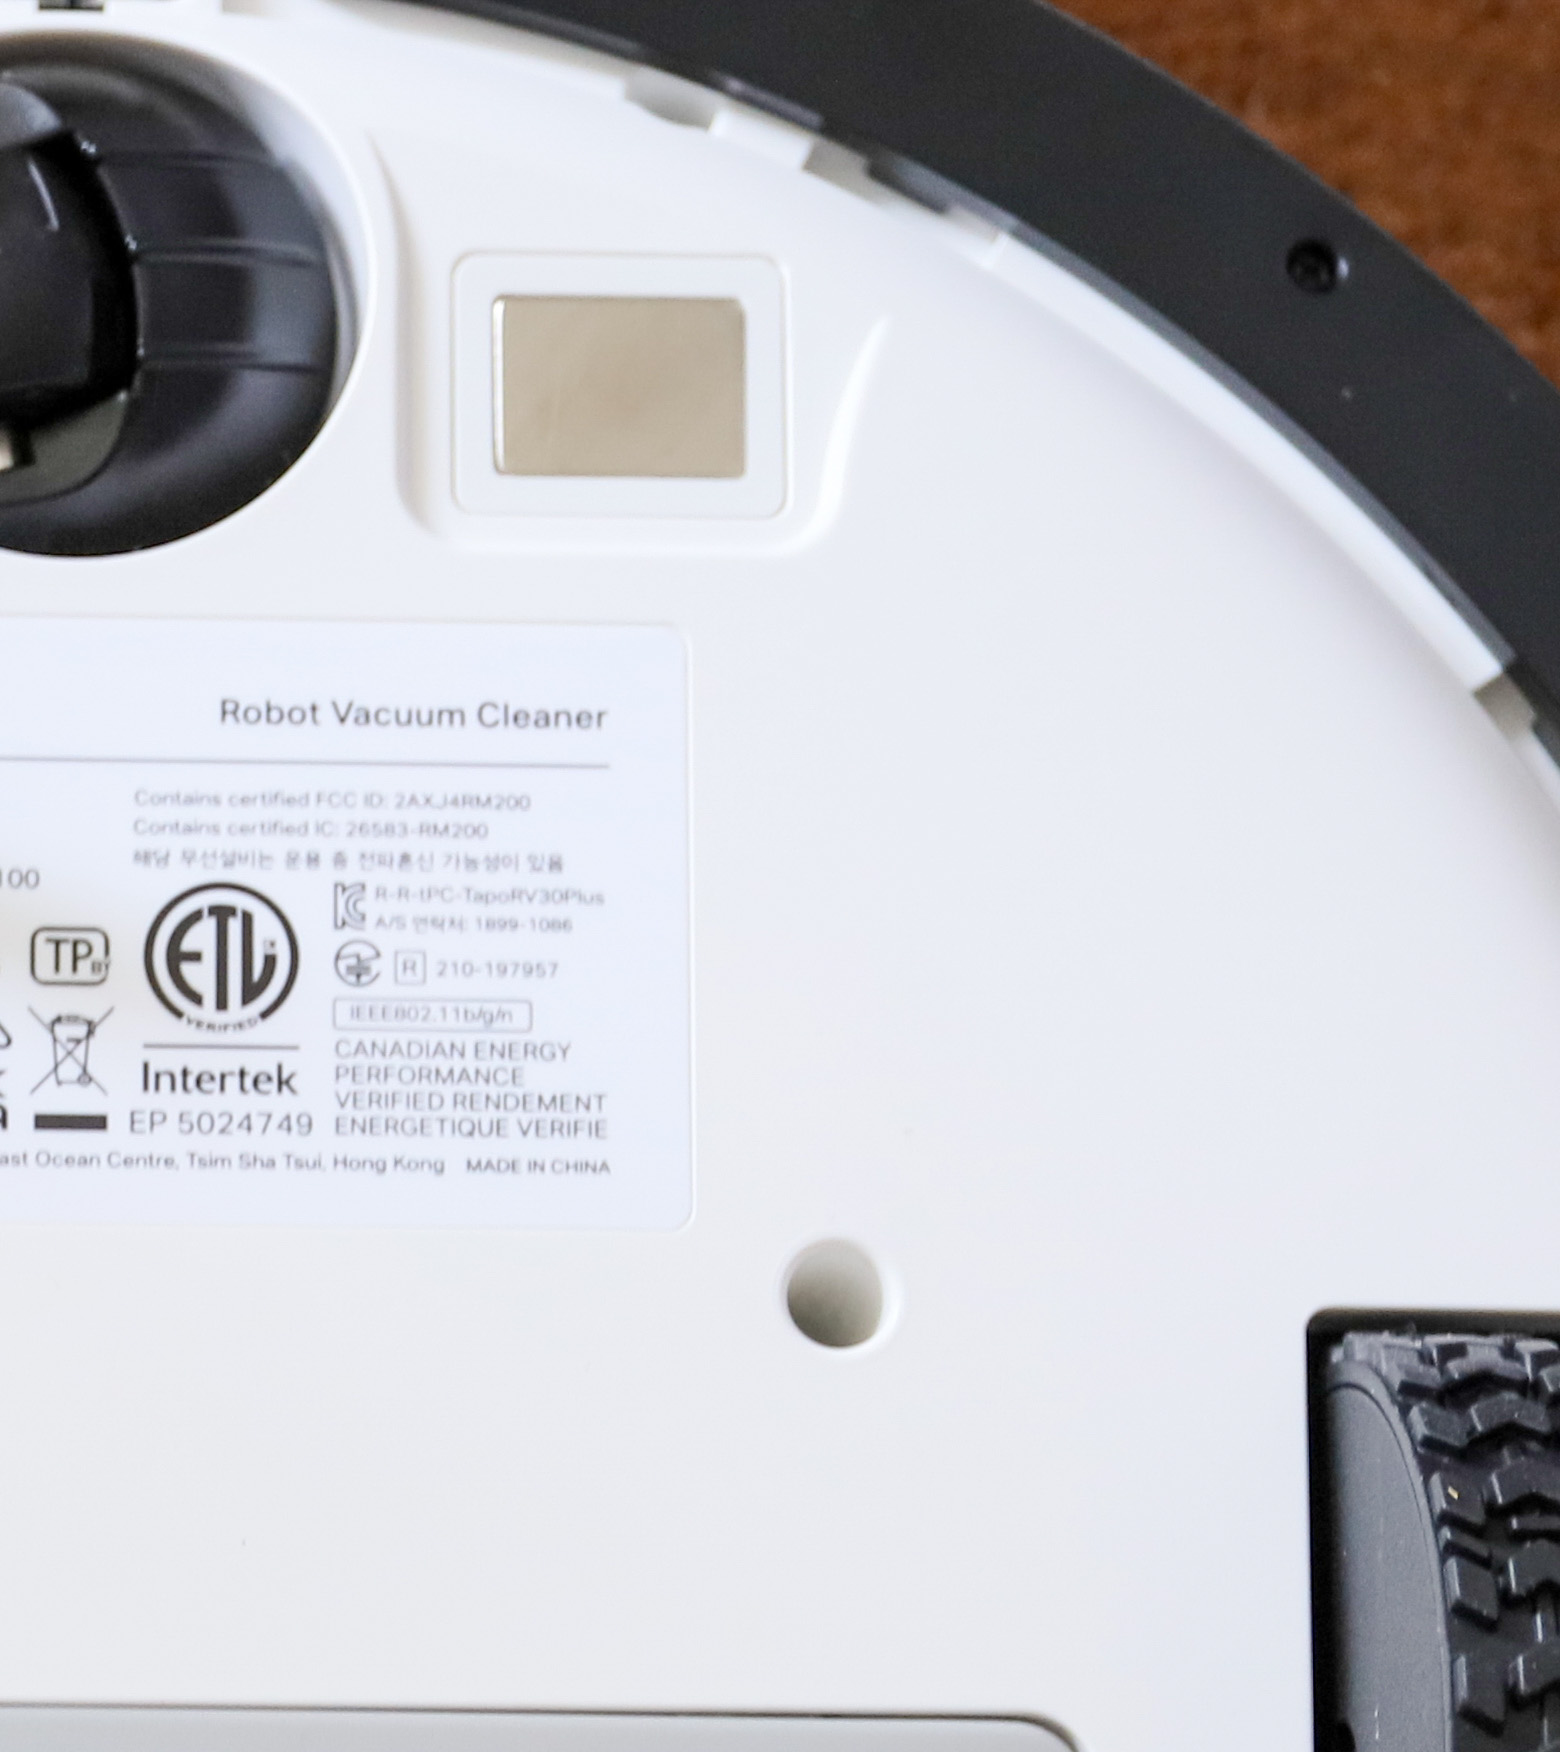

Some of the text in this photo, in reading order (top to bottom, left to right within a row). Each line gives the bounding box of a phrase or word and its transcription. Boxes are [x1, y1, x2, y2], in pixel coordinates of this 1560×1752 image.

[220, 698, 609, 731] Robot Vacuum Cleaner
[133, 787, 222, 808] Contains
[228, 789, 310, 809] certified
[315, 790, 358, 810] FCC
[132, 817, 221, 837] Contains
[226, 818, 309, 838] certified
[346, 820, 490, 841] 26583-RM200
[373, 914, 408, 932] A/S
[436, 960, 560, 980] 210-197957
[349, 1004, 514, 1027] IEEE802.11b/g/n
[334, 1040, 572, 1063] CANADIAN ENERGY
[141, 1059, 299, 1097] Intertek
[334, 1065, 525, 1088] PERFORMANCE
[334, 1090, 608, 1115] VERIFIED RENDEMENT
[129, 1110, 314, 1137] EP 5024749
[334, 1116, 608, 1141] ENERGETIQUE VERIFIE
[35, 1150, 101, 1170] Ocean
[106, 1150, 180, 1173] Centre,
[186, 1151, 232, 1171] Tsim
[238, 1152, 276, 1172] Sha
[282, 1152, 326, 1174] Tsui,
[333, 1153, 387, 1177] Hong
[393, 1155, 446, 1178] Kong
[465, 1157, 612, 1177] MADE IN CHINA
